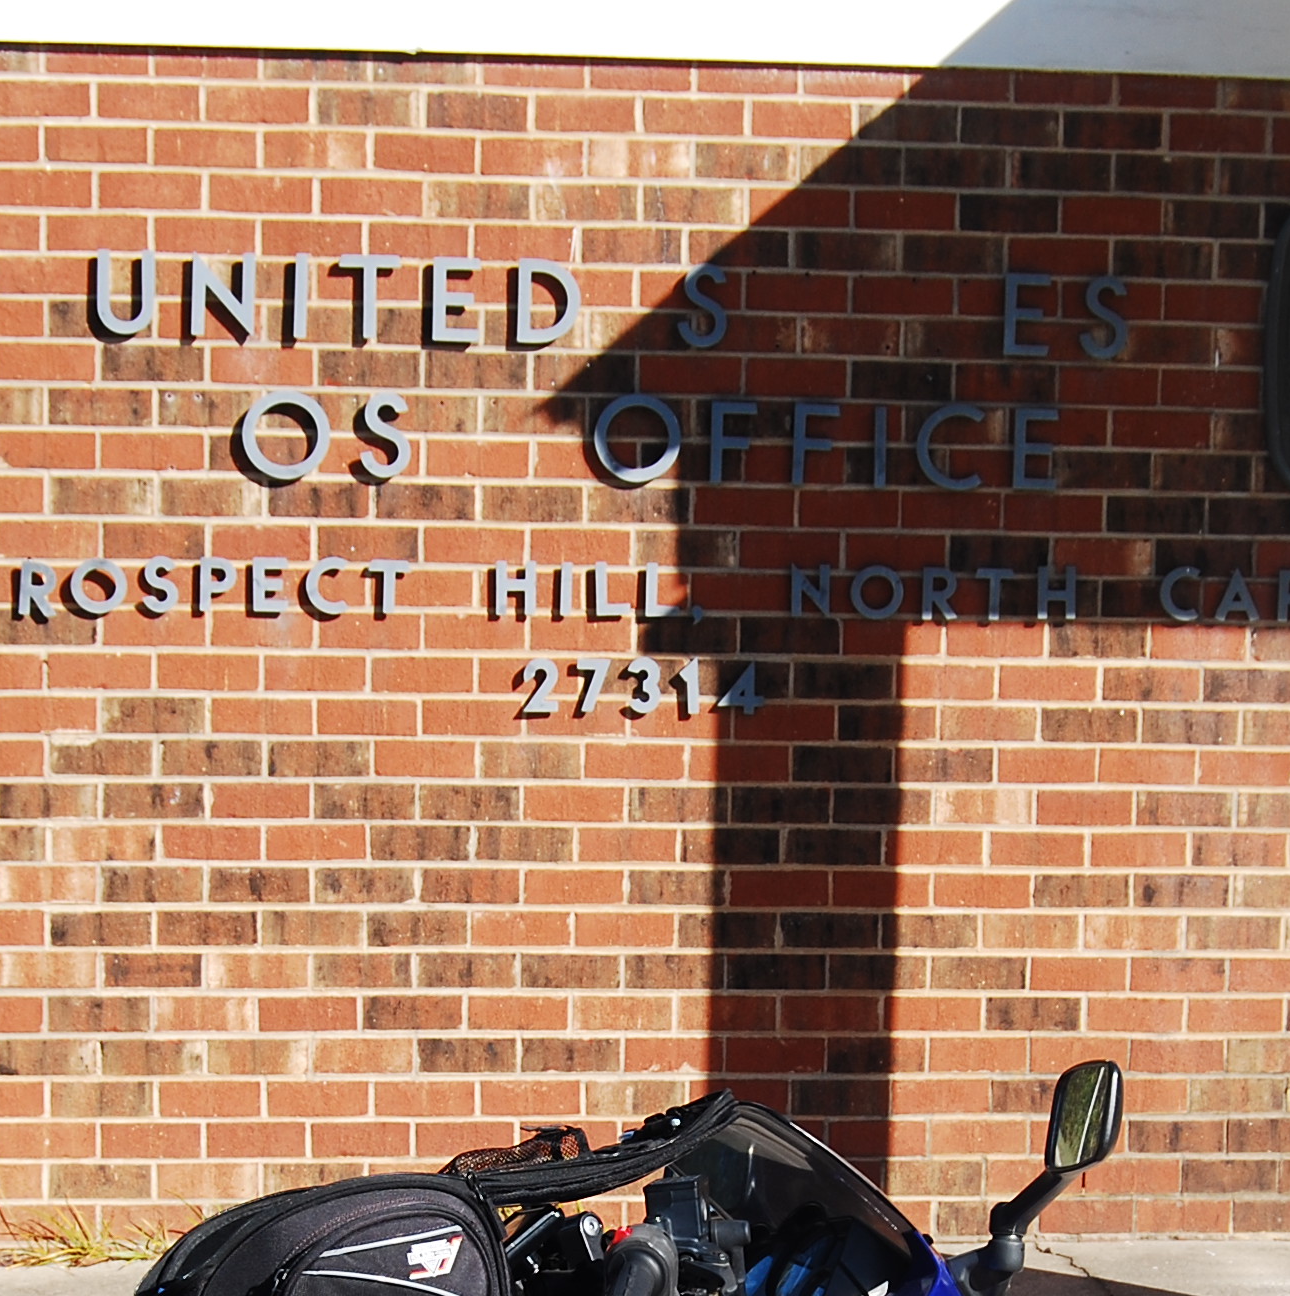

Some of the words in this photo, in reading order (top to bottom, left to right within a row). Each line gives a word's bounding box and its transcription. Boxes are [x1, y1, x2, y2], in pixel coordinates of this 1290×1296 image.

[95, 248, 582, 344] UNITED
[240, 389, 412, 482] OS
[593, 392, 1060, 492] OFFICE
[790, 562, 1078, 625] NORTH
[520, 657, 767, 717] 27314
